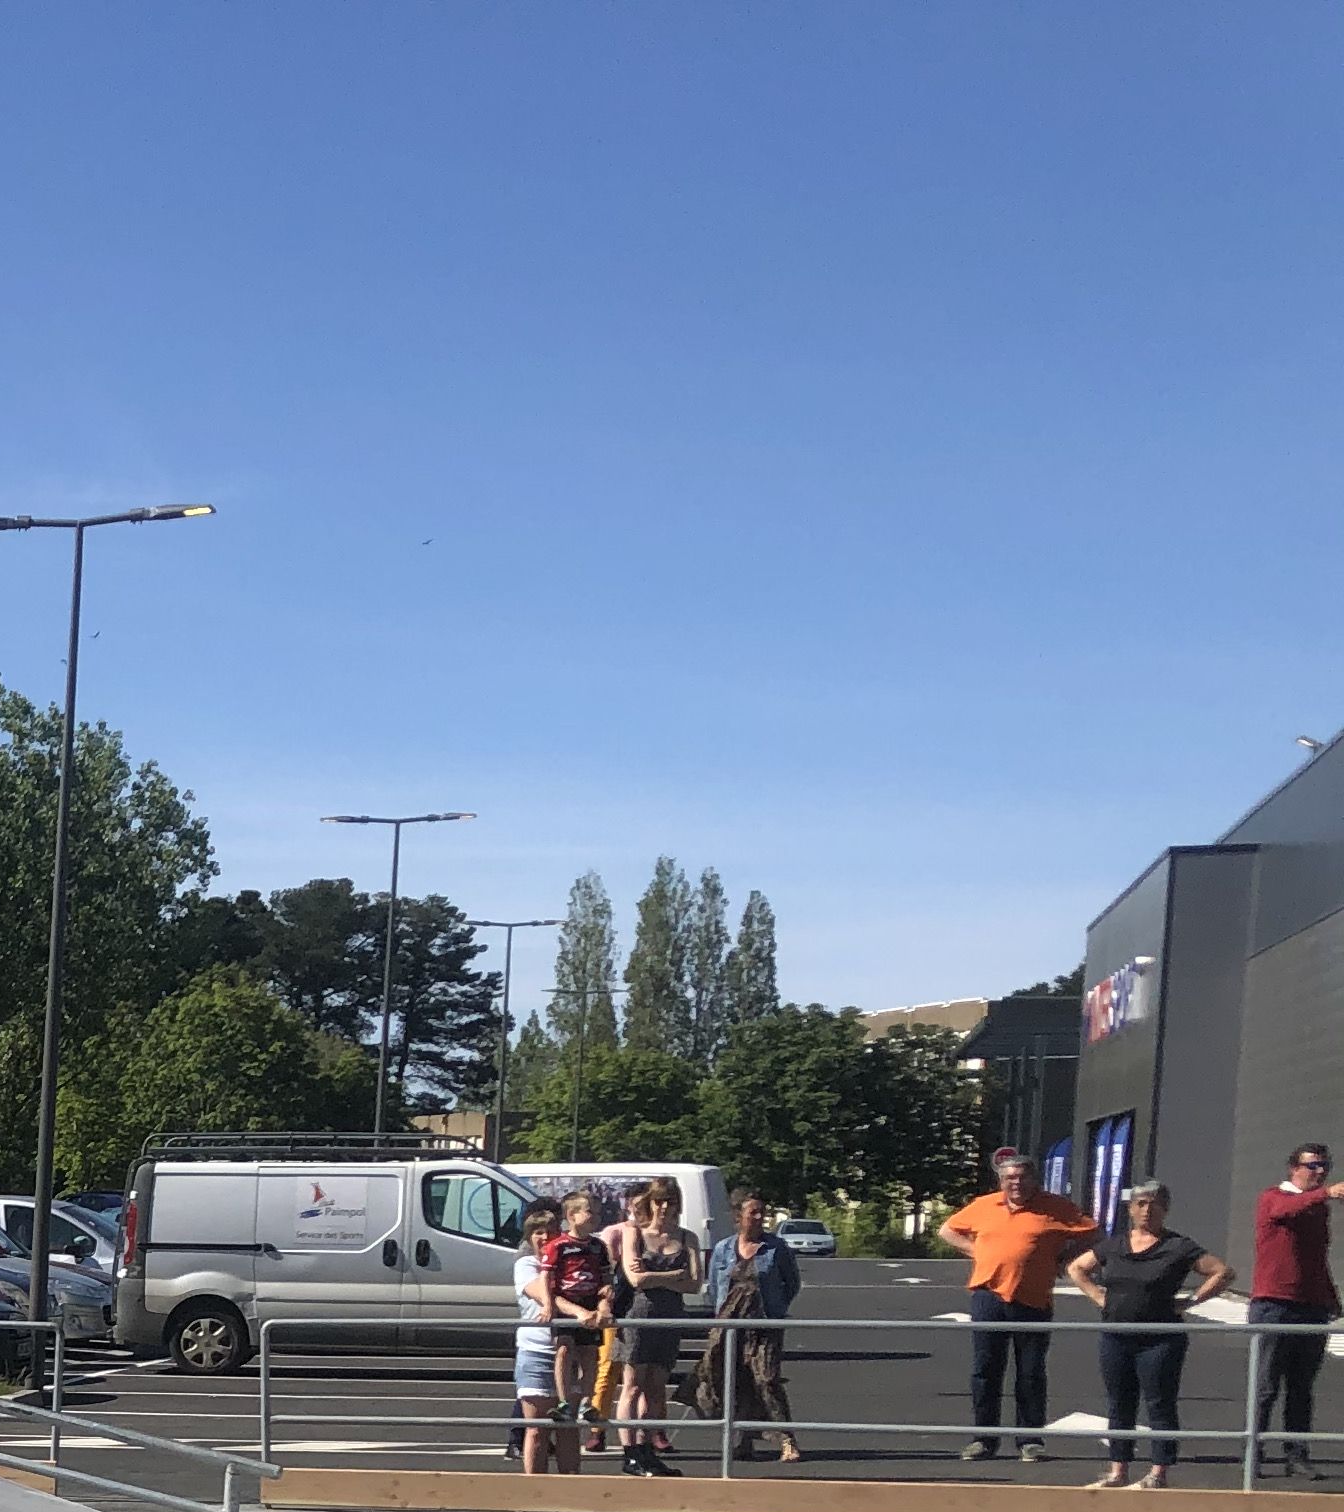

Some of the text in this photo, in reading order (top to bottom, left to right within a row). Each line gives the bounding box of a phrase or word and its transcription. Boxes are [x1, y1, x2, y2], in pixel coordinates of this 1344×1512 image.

[324, 1207, 366, 1218] Paimpol
[296, 1231, 322, 1239] Service
[340, 1231, 364, 1240] Sports
